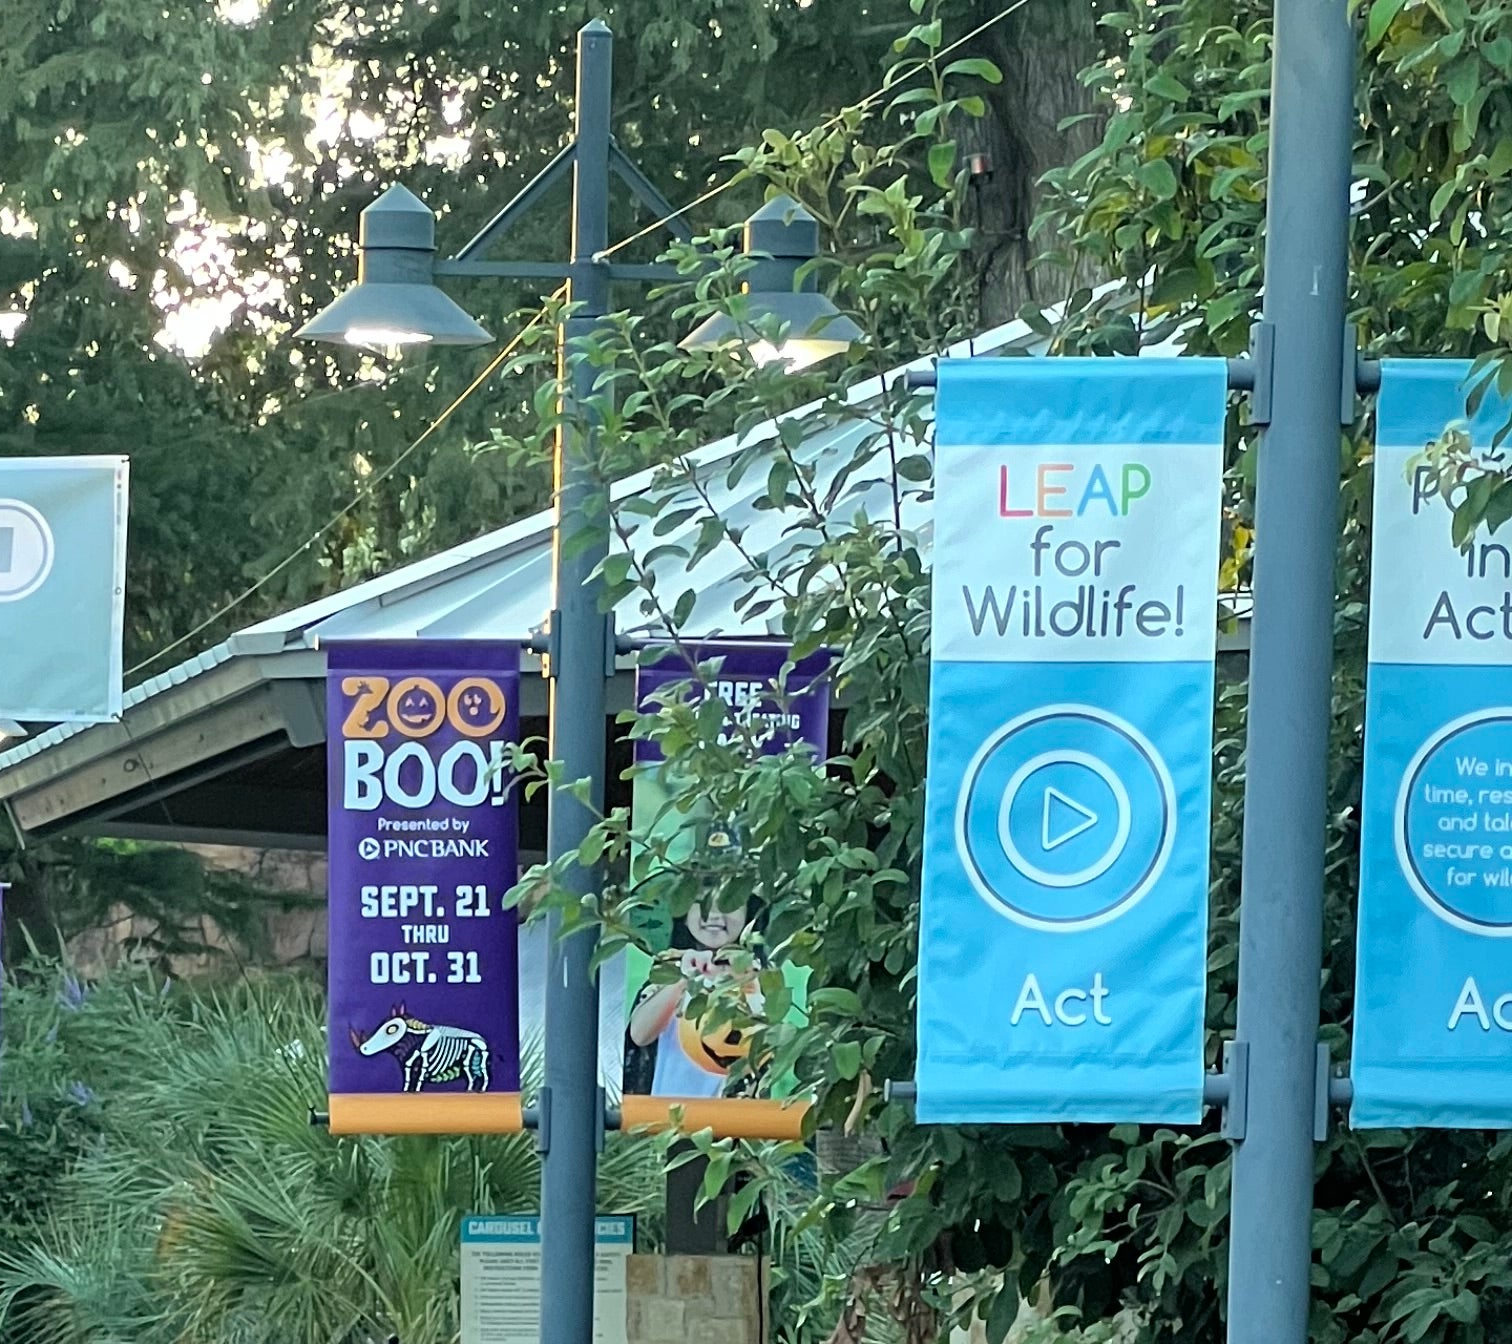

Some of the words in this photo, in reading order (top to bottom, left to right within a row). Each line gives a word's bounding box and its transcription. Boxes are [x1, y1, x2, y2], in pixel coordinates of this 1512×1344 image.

[999, 463, 1153, 518] LEAP
[1029, 524, 1122, 578] for
[961, 584, 1185, 638] Wildlife!
[341, 676, 507, 739] ZOO
[343, 739, 507, 812] BOO!
[1455, 756, 1489, 777] We
[1424, 783, 1473, 806] time,
[377, 816, 450, 832] Presented
[452, 817, 470, 834] by
[1437, 814, 1478, 832] and
[1423, 842, 1494, 860] secure
[1447, 867, 1477, 887] for
[360, 884, 445, 919] SEPT.
[455, 884, 491, 919] 21
[401, 924, 450, 944] THRU
[369, 951, 438, 985] OCT.
[446, 951, 482, 984] 31
[1010, 972, 1113, 1027] Act
